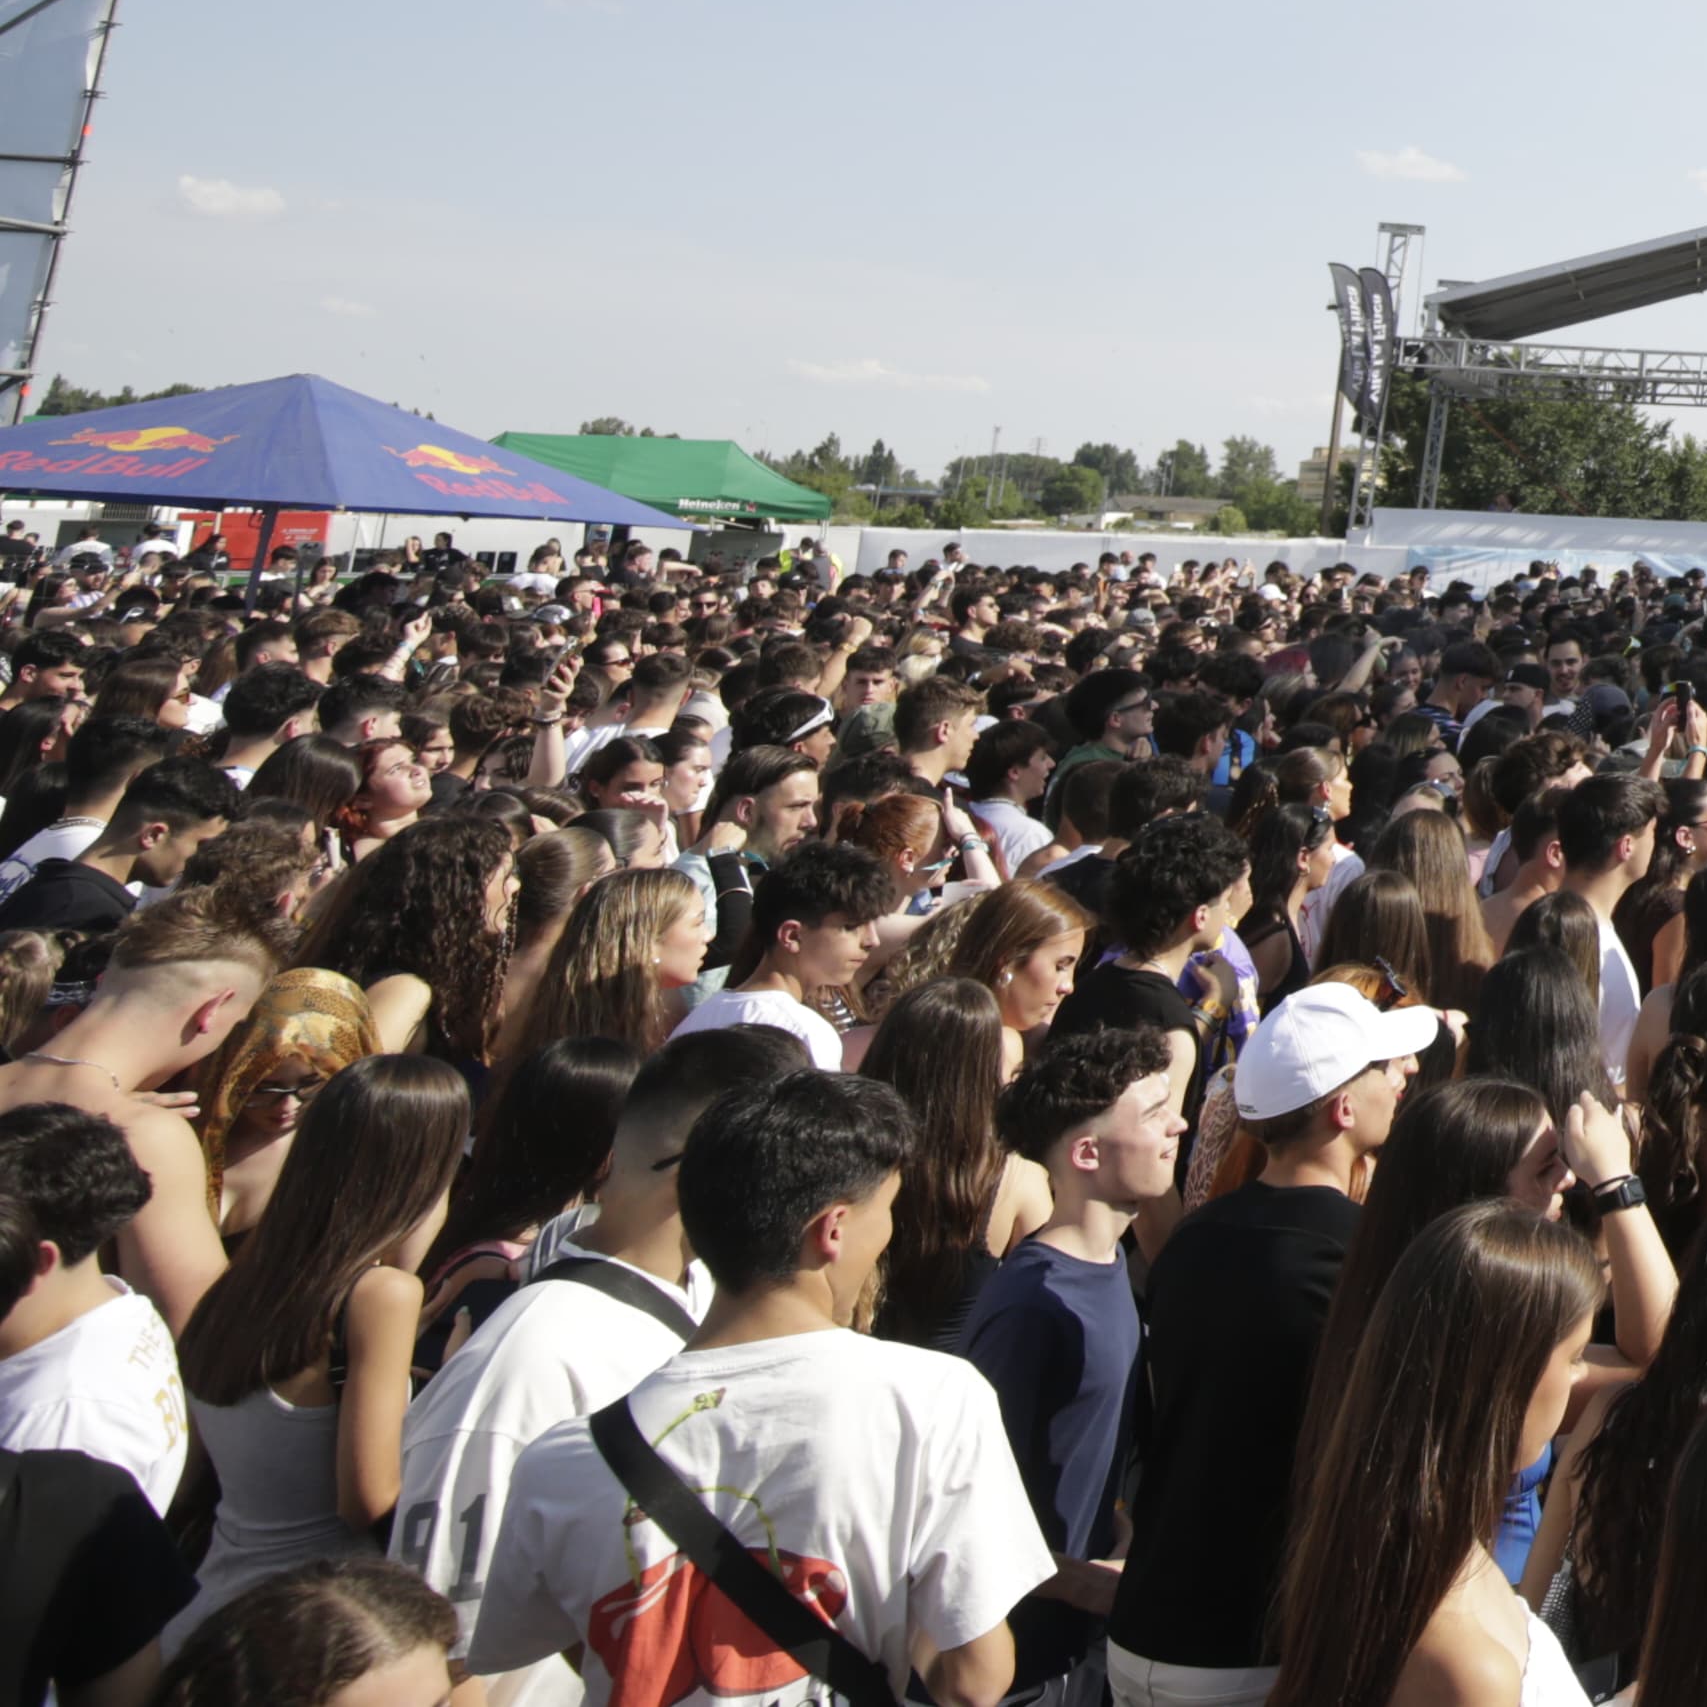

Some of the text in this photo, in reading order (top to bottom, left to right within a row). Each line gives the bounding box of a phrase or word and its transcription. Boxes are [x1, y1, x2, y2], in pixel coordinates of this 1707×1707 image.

[0, 450, 208, 479] Red Bull
[677, 498, 741, 511] Heineken
